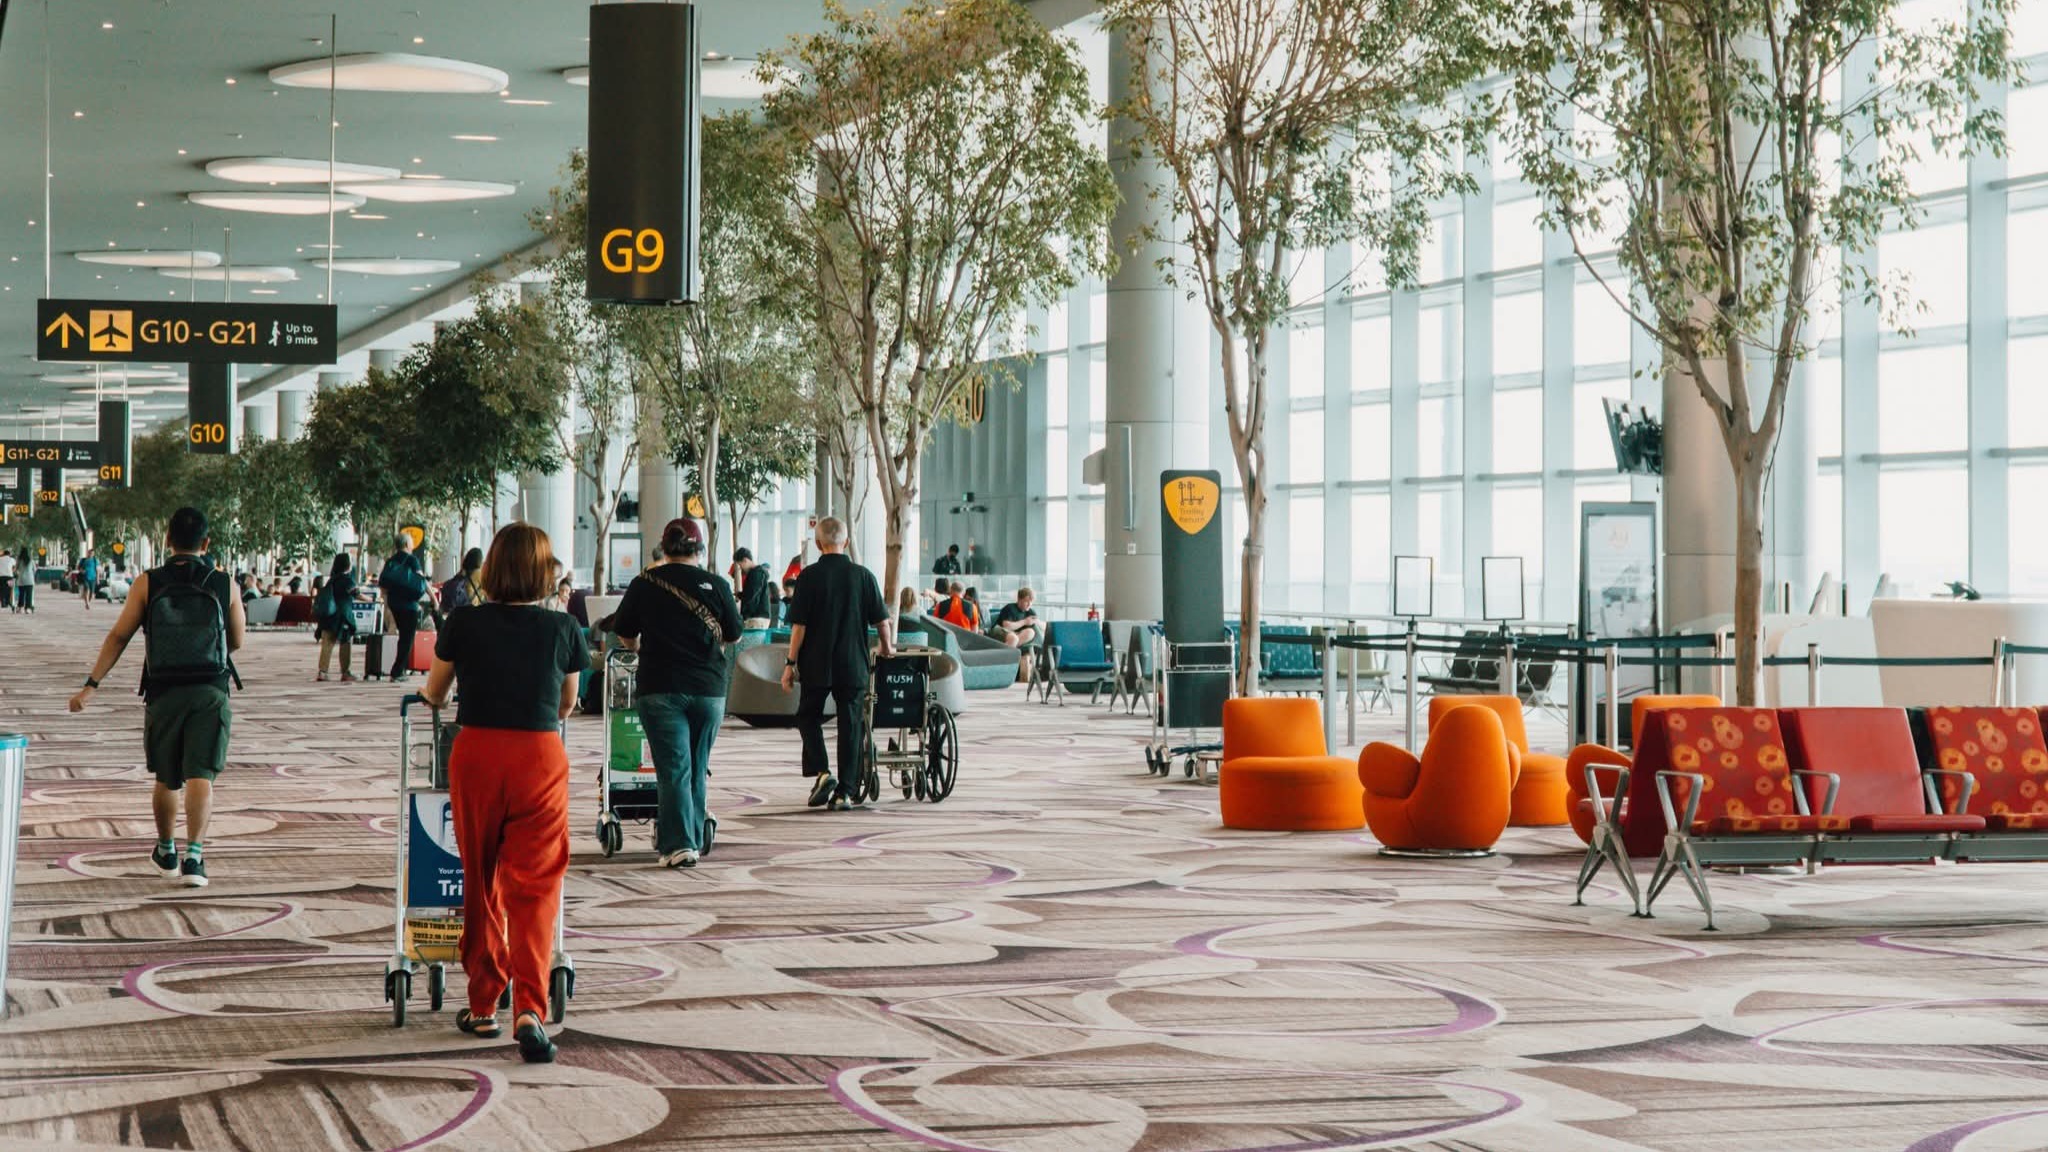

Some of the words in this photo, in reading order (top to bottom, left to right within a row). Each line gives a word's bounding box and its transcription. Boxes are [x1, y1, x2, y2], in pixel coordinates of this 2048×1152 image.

[601, 228, 665, 273] G9
[286, 323, 300, 335] Up
[302, 324, 313, 333] to
[286, 336, 293, 345] 9
[295, 336, 318, 345] mins
[190, 423, 225, 443] G10
[100, 465, 121, 480] G11
[41, 491, 58, 502] G12
[886, 675, 913, 683] RUSH
[892, 690, 904, 699] T4
[438, 867, 454, 875] Your
[437, 880, 463, 896] Tri
